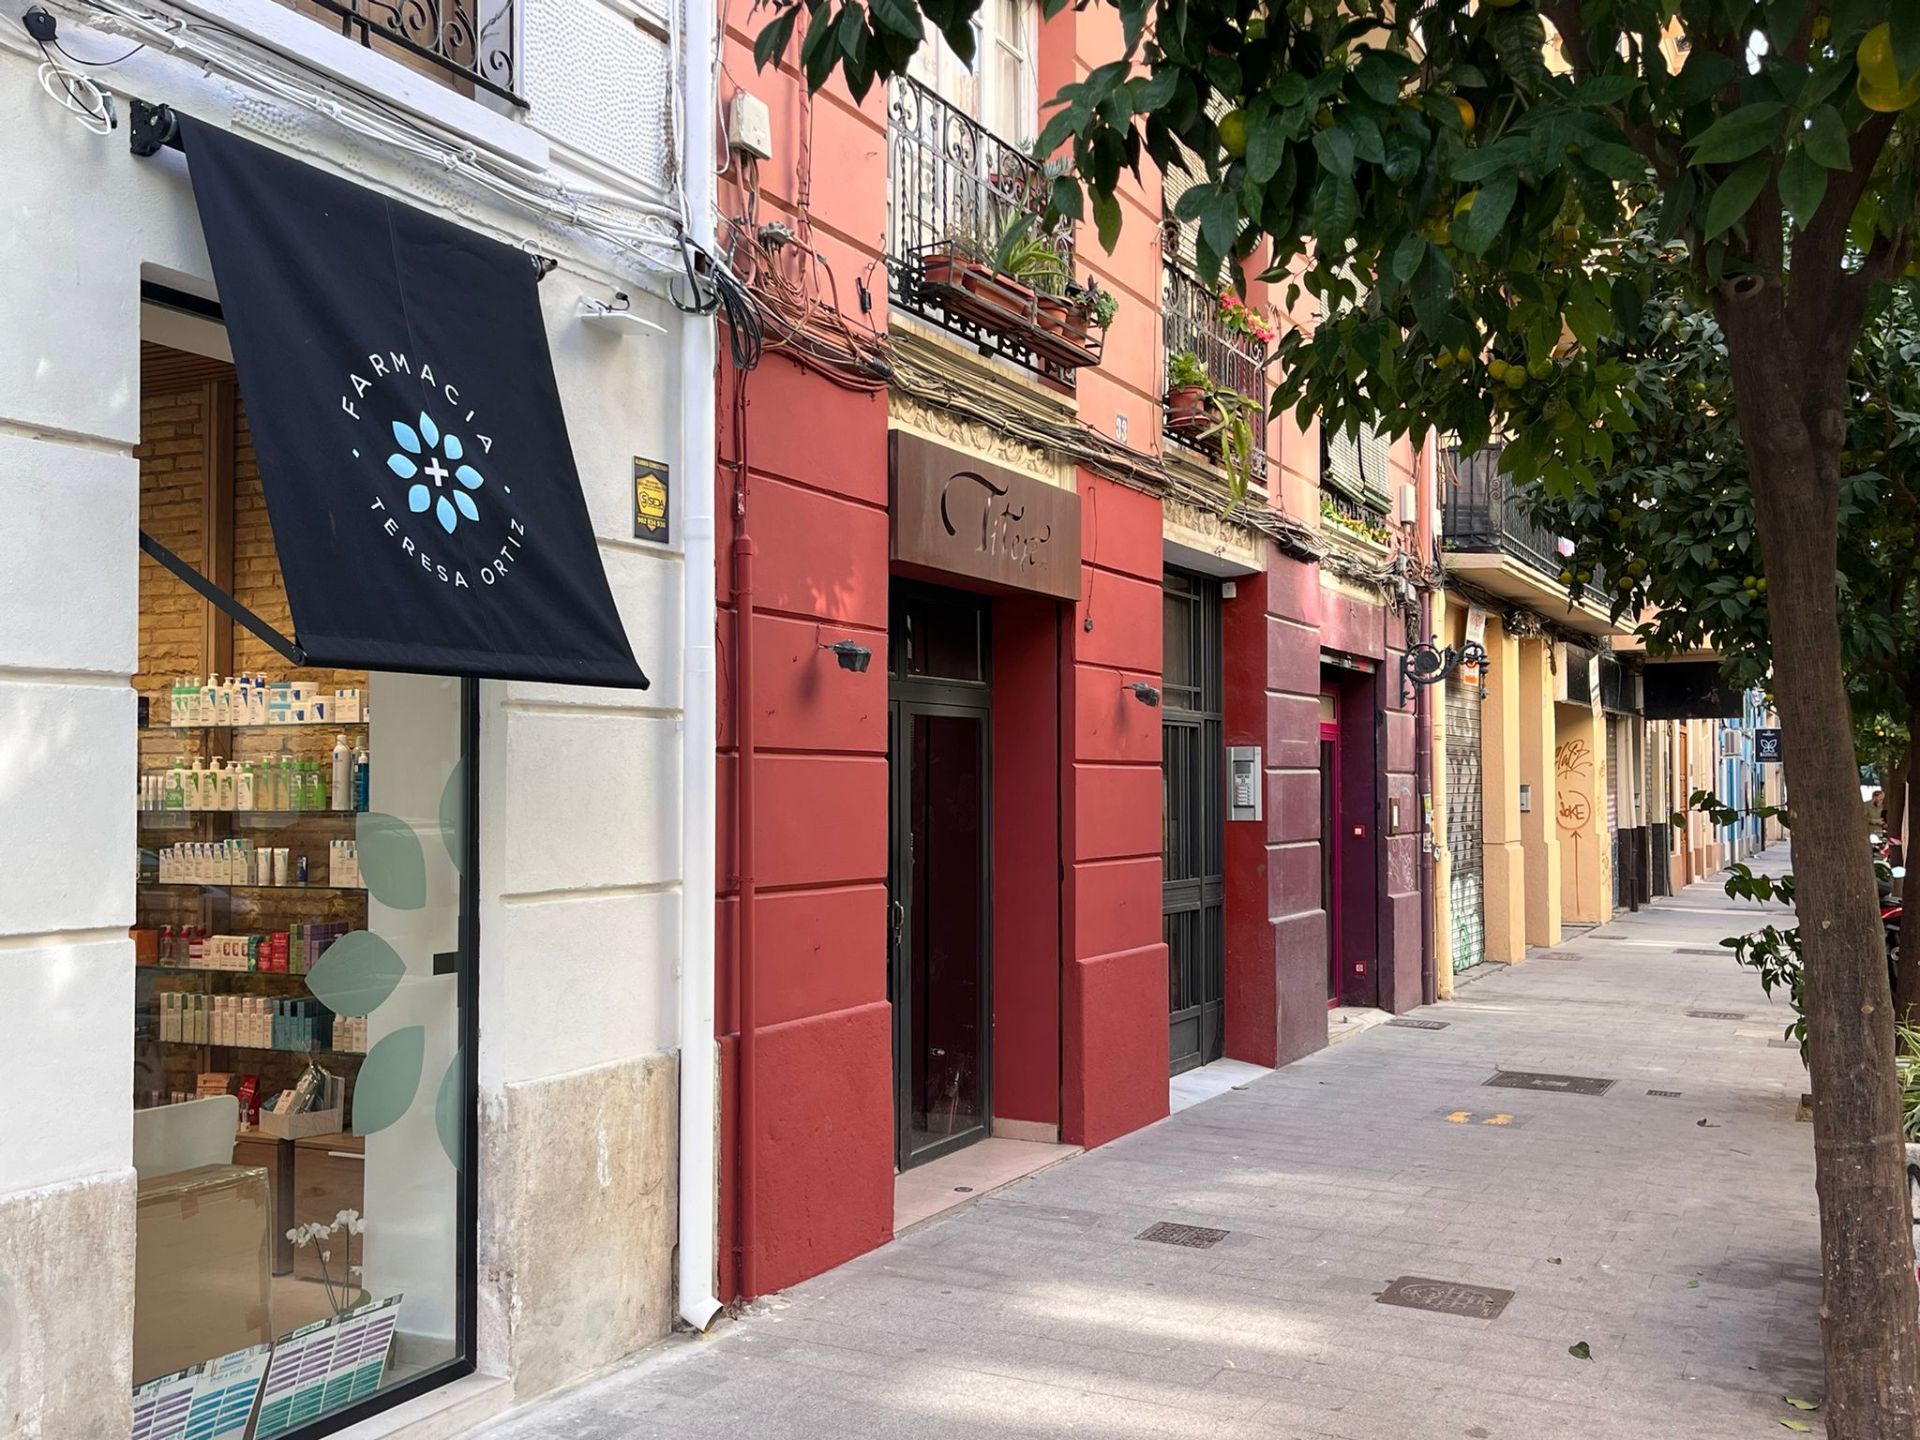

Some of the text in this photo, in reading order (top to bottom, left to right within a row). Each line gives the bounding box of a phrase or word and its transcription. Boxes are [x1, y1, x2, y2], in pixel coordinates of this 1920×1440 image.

[342, 351, 492, 454] FARMACIA
[370, 496, 525, 588] TERESA ORTIZ
